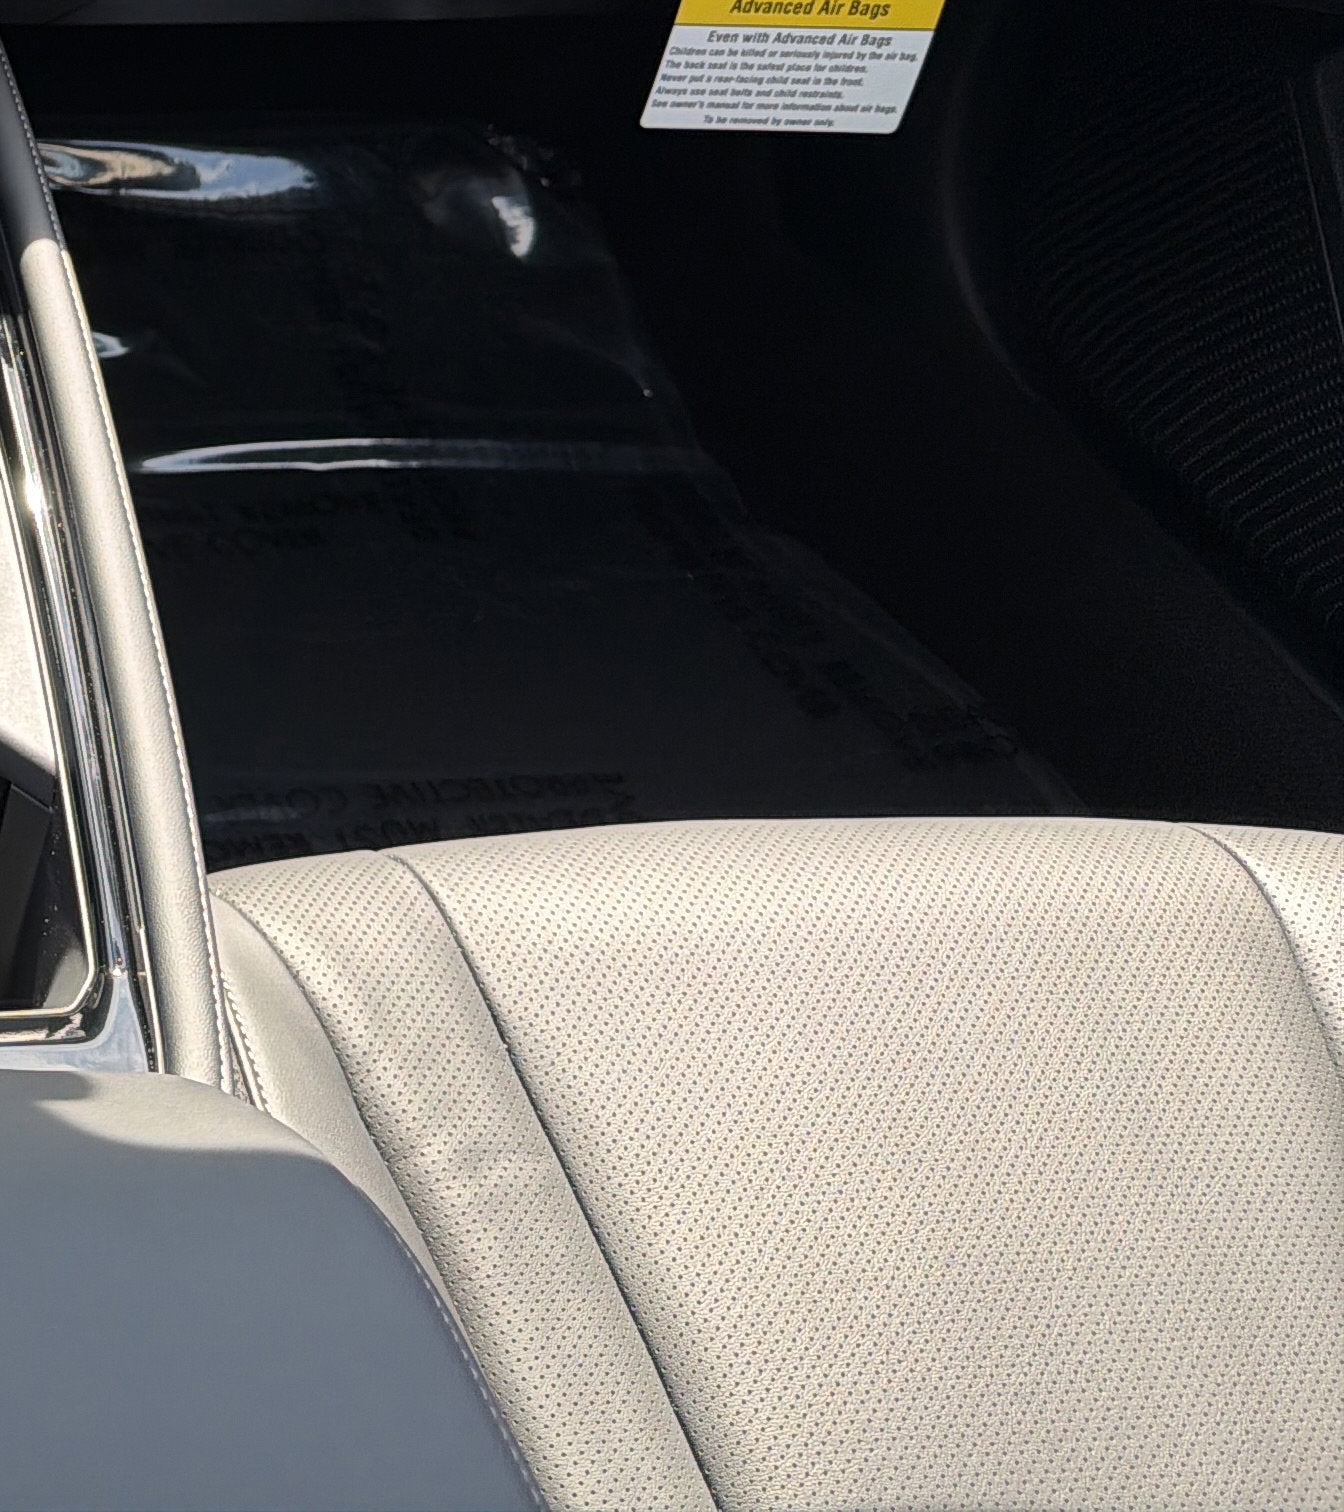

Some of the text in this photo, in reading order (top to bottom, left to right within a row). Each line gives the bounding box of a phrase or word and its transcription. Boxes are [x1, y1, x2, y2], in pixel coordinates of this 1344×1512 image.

[817, 0, 845, 16] Air
[848, 0, 891, 20] Bags
[707, 31, 893, 49] Even with Advanced Air Bags
[669, 46, 707, 56] Children
[708, 48, 726, 57] can
[726, 48, 738, 57] be
[740, 48, 767, 58] killed
[767, 50, 777, 58] or
[822, 50, 854, 60] injured
[856, 51, 867, 61] by
[868, 51, 883, 60] the
[884, 52, 898, 61] air
[899, 52, 918, 62] bag.
[666, 59, 682, 69] The
[683, 60, 706, 69] back
[707, 61, 728, 70] seat
[729, 61, 737, 70] is
[739, 61, 755, 70] the
[756, 62, 785, 71] safest
[785, 64, 812, 73] place
[813, 64, 827, 72] for
[660, 73, 688, 82] Never
[688, 74, 705, 84] put
[705, 75, 712, 83] a
[765, 75, 790, 84] child
[790, 76, 811, 85] seat
[812, 77, 821, 85] in
[823, 77, 838, 86] the
[840, 77, 864, 86] front.
[655, 86, 688, 96] Always
[690, 88, 706, 96] use
[708, 88, 728, 96] seat
[730, 88, 753, 97] belts
[754, 89, 772, 97] and
[773, 89, 798, 98] child
